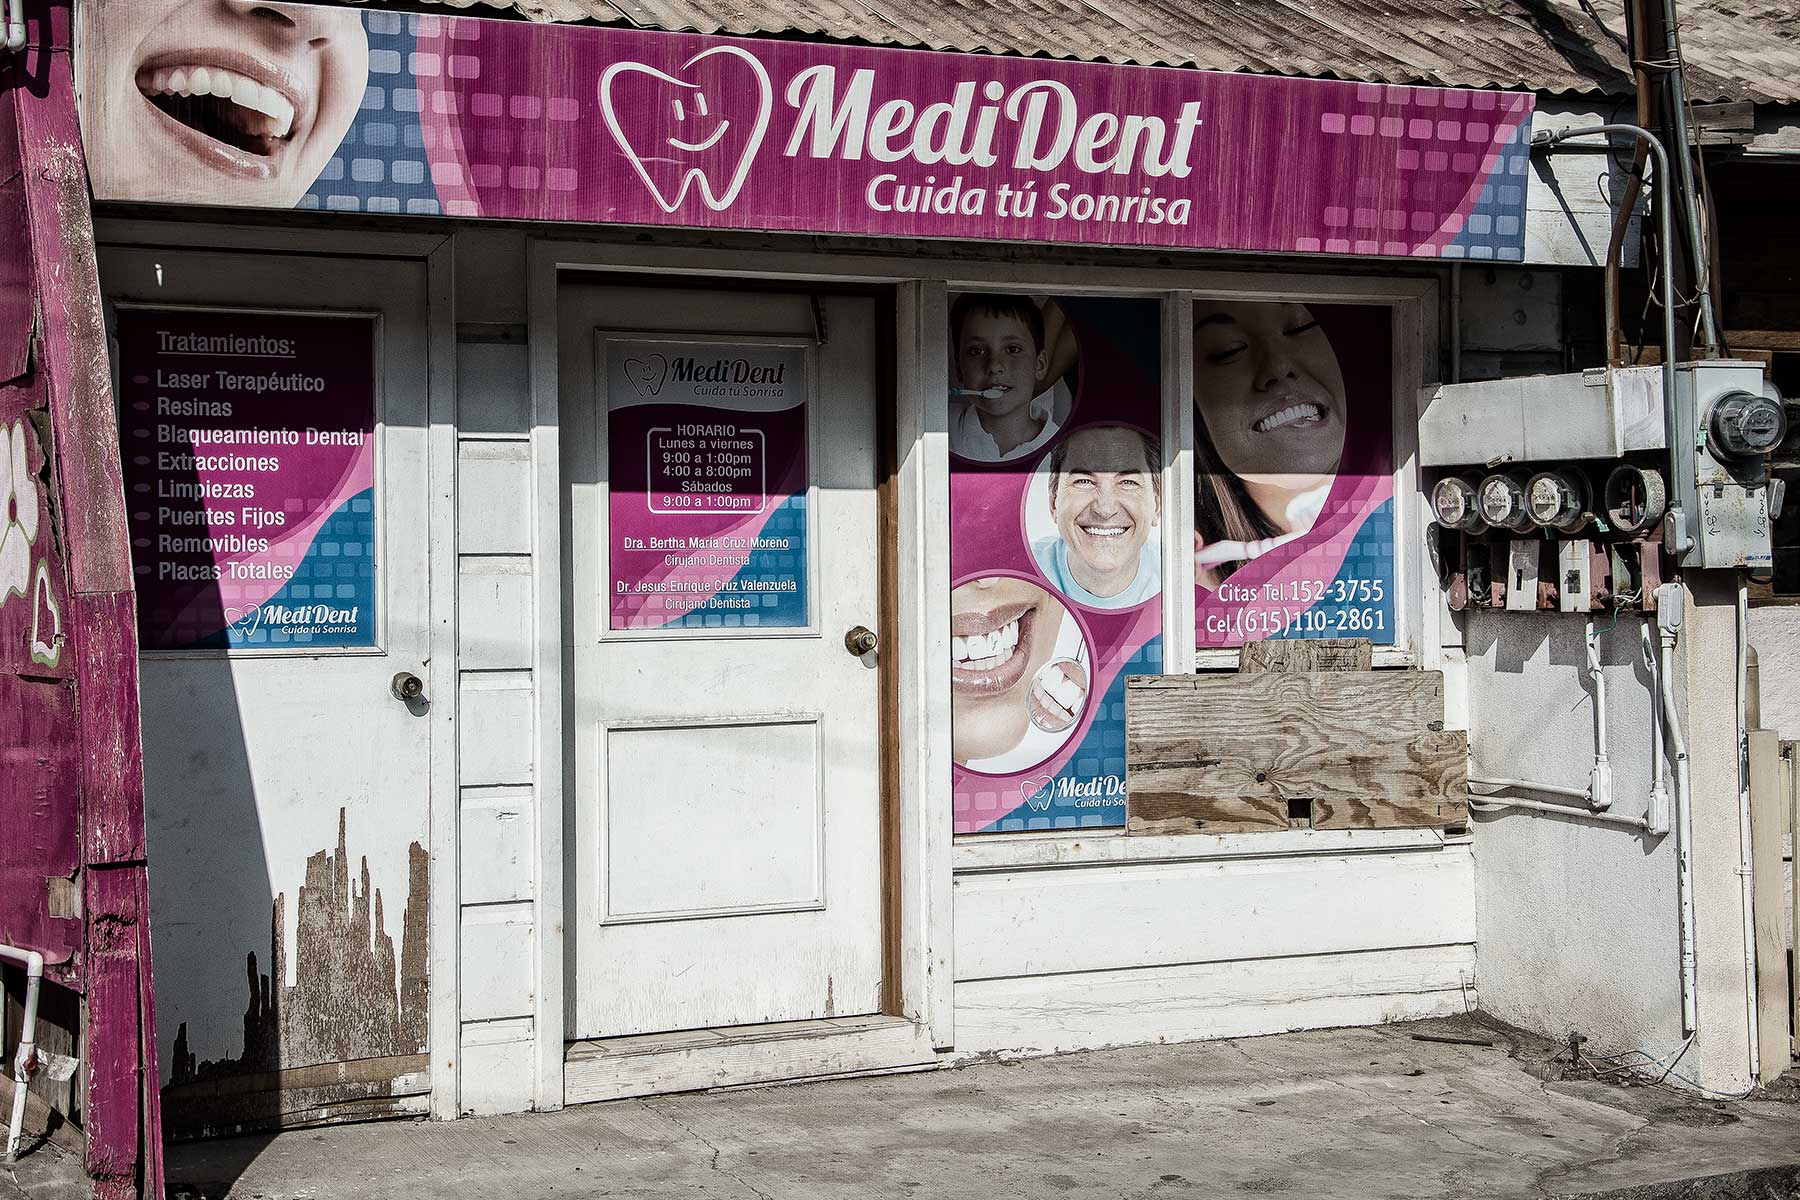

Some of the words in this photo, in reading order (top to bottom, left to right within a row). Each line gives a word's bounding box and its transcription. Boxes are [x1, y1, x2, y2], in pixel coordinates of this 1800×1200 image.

[784, 64, 1203, 178] MediDent
[866, 173, 985, 217] Cuida
[995, 180, 1037, 218] tú
[1046, 182, 1192, 226] Sonrisa
[156, 331, 296, 355] Tratamientos:
[671, 356, 785, 385] MediDent
[157, 370, 209, 389] Laser
[215, 371, 325, 393] Terapéutico
[694, 385, 726, 396] Cuida
[729, 386, 740, 396] tú
[743, 386, 784, 398] Sonrisa
[157, 398, 232, 417] Resinas
[158, 424, 299, 447] Blaqueamiento
[306, 428, 364, 446] Dental
[677, 425, 736, 437] HORARIO
[659, 438, 695, 449] Lunes
[700, 441, 706, 449] a
[710, 438, 754, 450] viernes
[158, 452, 279, 471] Extracciones
[663, 453, 690, 463] 9:00
[695, 455, 702, 463] a
[707, 453, 751, 466] 1:00pm
[663, 466, 690, 476] 4:00
[695, 468, 702, 476] a
[706, 467, 751, 479] 8:00pm
[158, 480, 255, 501] Limpiezas
[682, 480, 732, 492] Sábados
[663, 496, 690, 507] 9:00
[695, 498, 701, 507] a
[706, 497, 751, 509] 1:00pm
[159, 507, 235, 525] Puentes
[241, 508, 285, 529] Fijos
[159, 535, 268, 553] Removibles
[624, 538, 647, 549] Dra.
[650, 538, 685, 549] Bertha
[689, 538, 718, 549] María
[723, 538, 746, 548] Cruz
[750, 537, 789, 548] Moreno
[665, 555, 706, 567] Cirujano
[710, 555, 750, 565] Dentista
[159, 562, 221, 580] Placas
[227, 562, 294, 580] Totales
[617, 581, 632, 592] Dr.
[635, 581, 666, 592] Jesus
[670, 581, 710, 593] Enrique
[714, 581, 738, 591] Cruz
[741, 580, 796, 591] Valenzuela
[1218, 583, 1257, 602] Citas
[665, 598, 707, 610] Cirujano
[710, 598, 751, 609] Dentista
[264, 604, 358, 624] MediDent
[282, 624, 309, 634] Cuida
[311, 625, 320, 634] tú
[323, 624, 357, 634] Sonrisa
[1075, 798, 1100, 808] Cuida
[1102, 798, 1111, 806] tú
